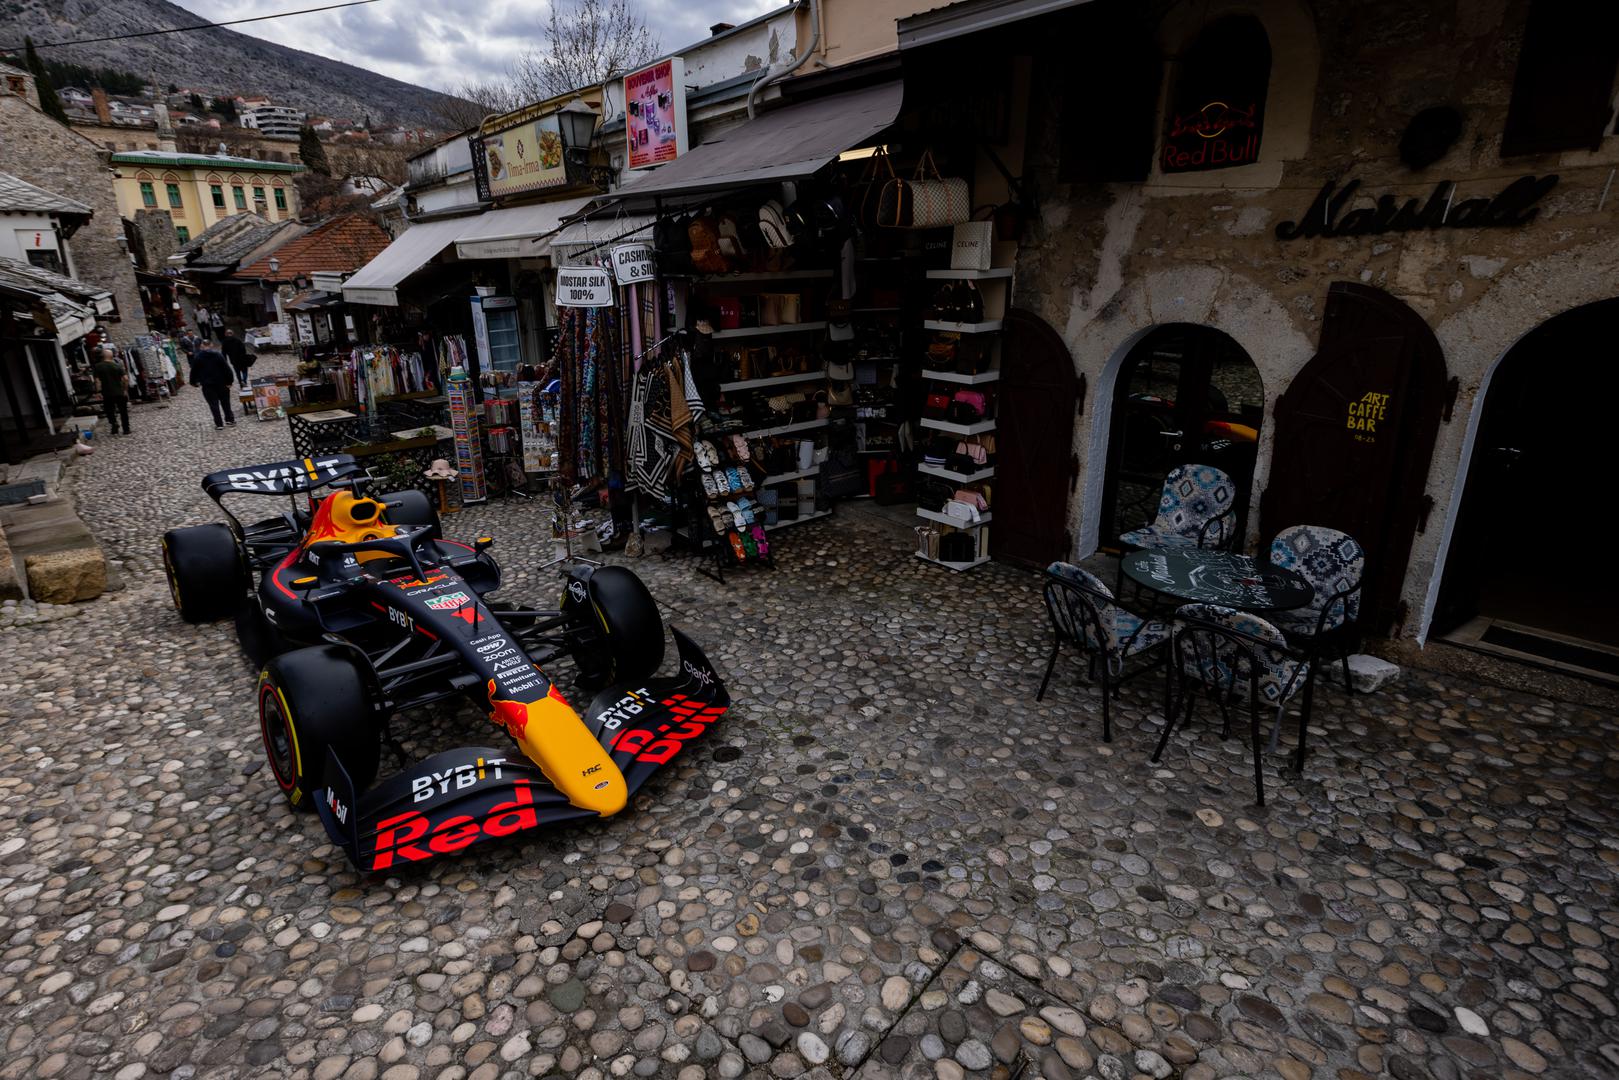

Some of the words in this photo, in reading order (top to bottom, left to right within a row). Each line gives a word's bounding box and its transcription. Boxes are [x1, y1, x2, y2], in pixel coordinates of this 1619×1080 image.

[655, 63, 671, 80] SHOP
[1162, 140, 1207, 168] Red
[1210, 132, 1257, 164] Bull
[1275, 175, 1559, 239] Marshall
[956, 240, 979, 248] CELINE
[560, 276, 588, 288] MOSTAR
[589, 275, 606, 287] SILK
[630, 266, 640, 277] &
[570, 289, 594, 300] 100%
[1360, 391, 1390, 406] ART
[1348, 401, 1387, 421] CAFFE
[1346, 415, 1376, 433] BAR
[227, 457, 340, 491] BYBIT
[387, 605, 414, 632] BYBIT
[483, 648, 516, 663] zoom
[683, 660, 714, 685] Claro
[596, 686, 656, 730] BYBIT
[609, 693, 729, 765] Bull
[412, 757, 506, 803] BYBIT
[582, 763, 602, 777] HRC
[326, 786, 348, 825] Mobil
[371, 778, 537, 872] Red
